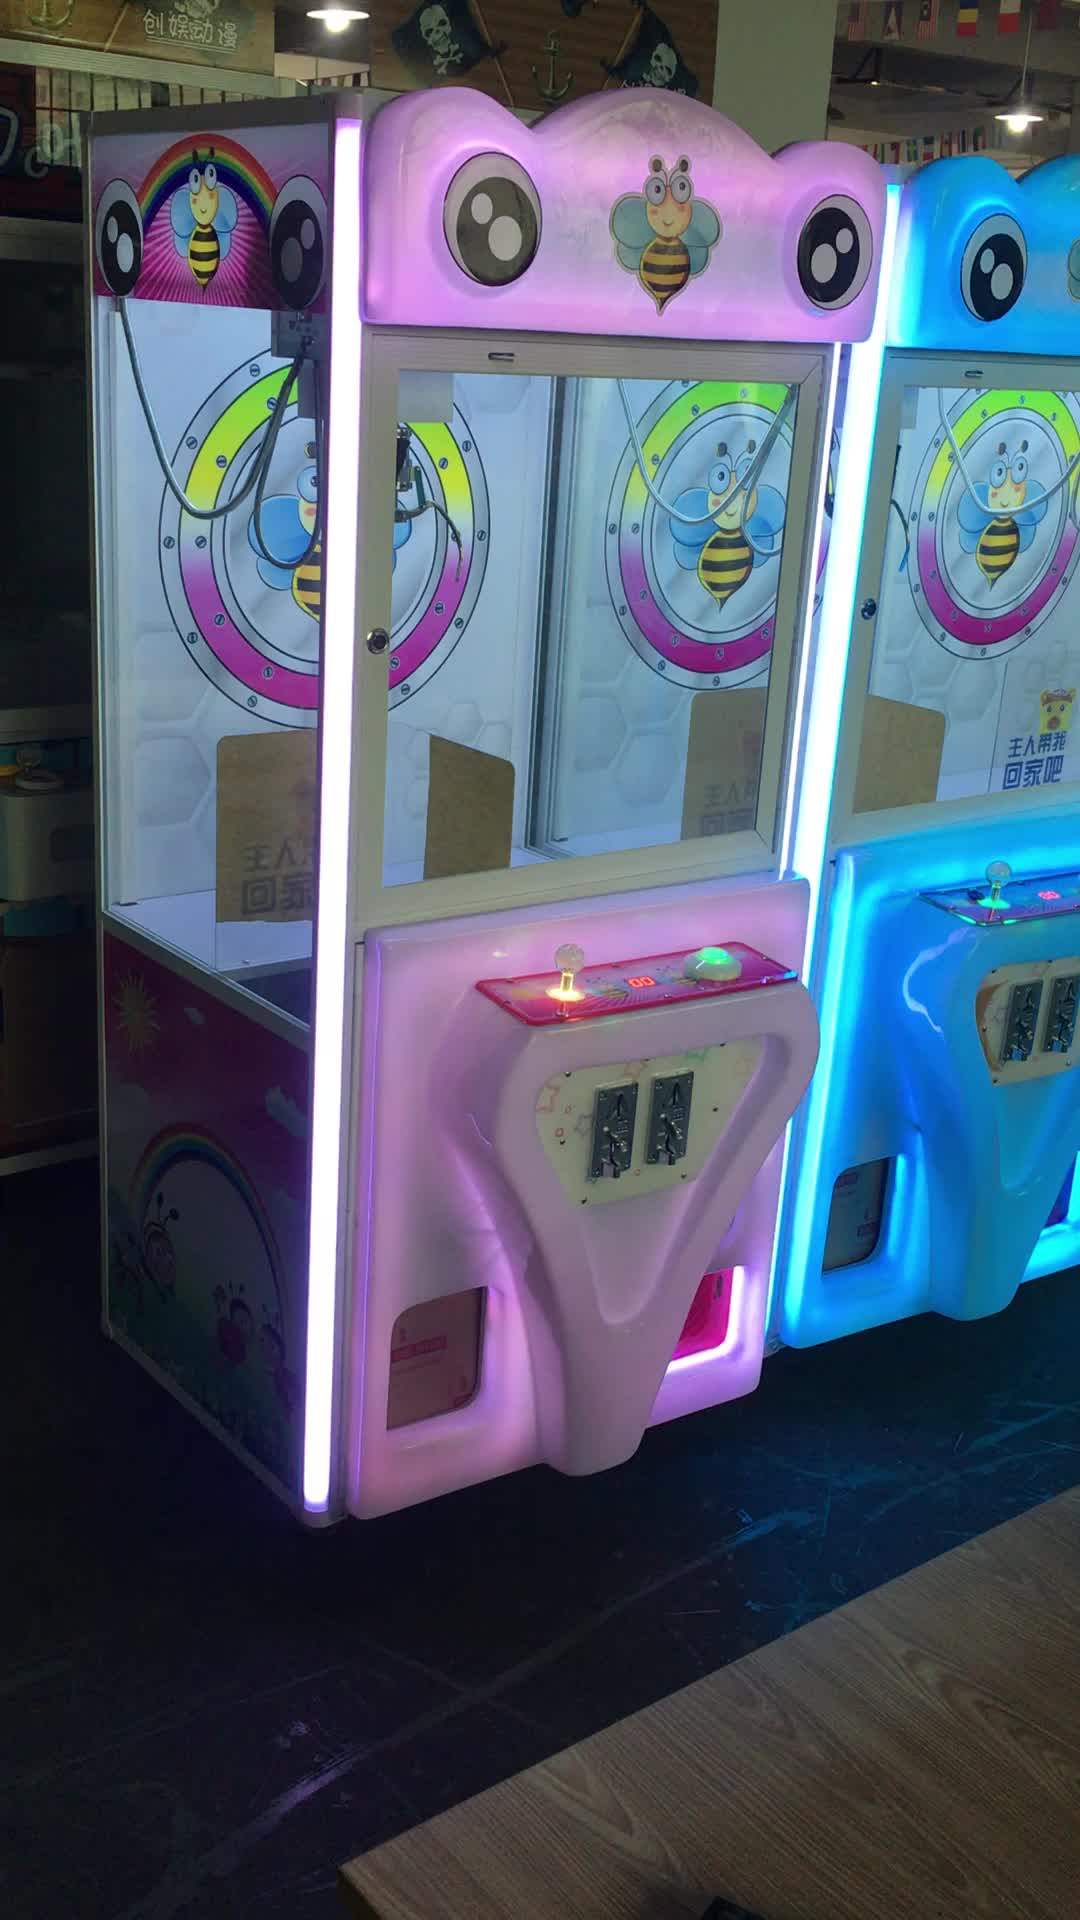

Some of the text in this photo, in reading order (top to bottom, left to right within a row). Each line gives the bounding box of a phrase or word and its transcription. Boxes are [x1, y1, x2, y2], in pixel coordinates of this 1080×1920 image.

[143, 9, 238, 48] 创娱动漫
[1008, 731, 1067, 758] 主人带我
[1002, 755, 1064, 789] 回家吧
